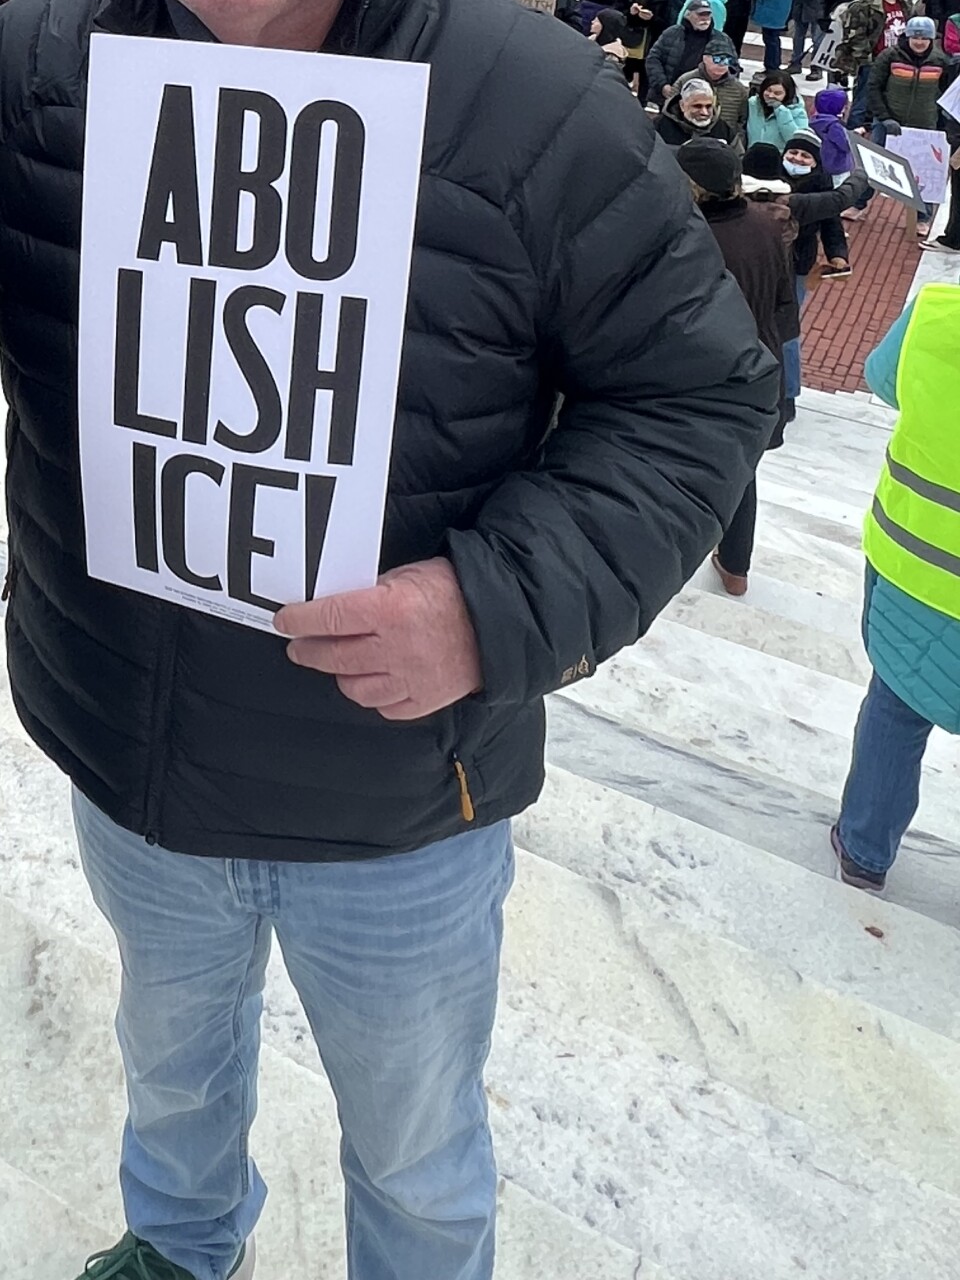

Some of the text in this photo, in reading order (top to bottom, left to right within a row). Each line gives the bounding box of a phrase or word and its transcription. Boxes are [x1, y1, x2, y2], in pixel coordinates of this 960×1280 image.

[137, 84, 366, 281] ABO
[113, 268, 368, 466] LISH
[133, 441, 338, 614] ICE!
